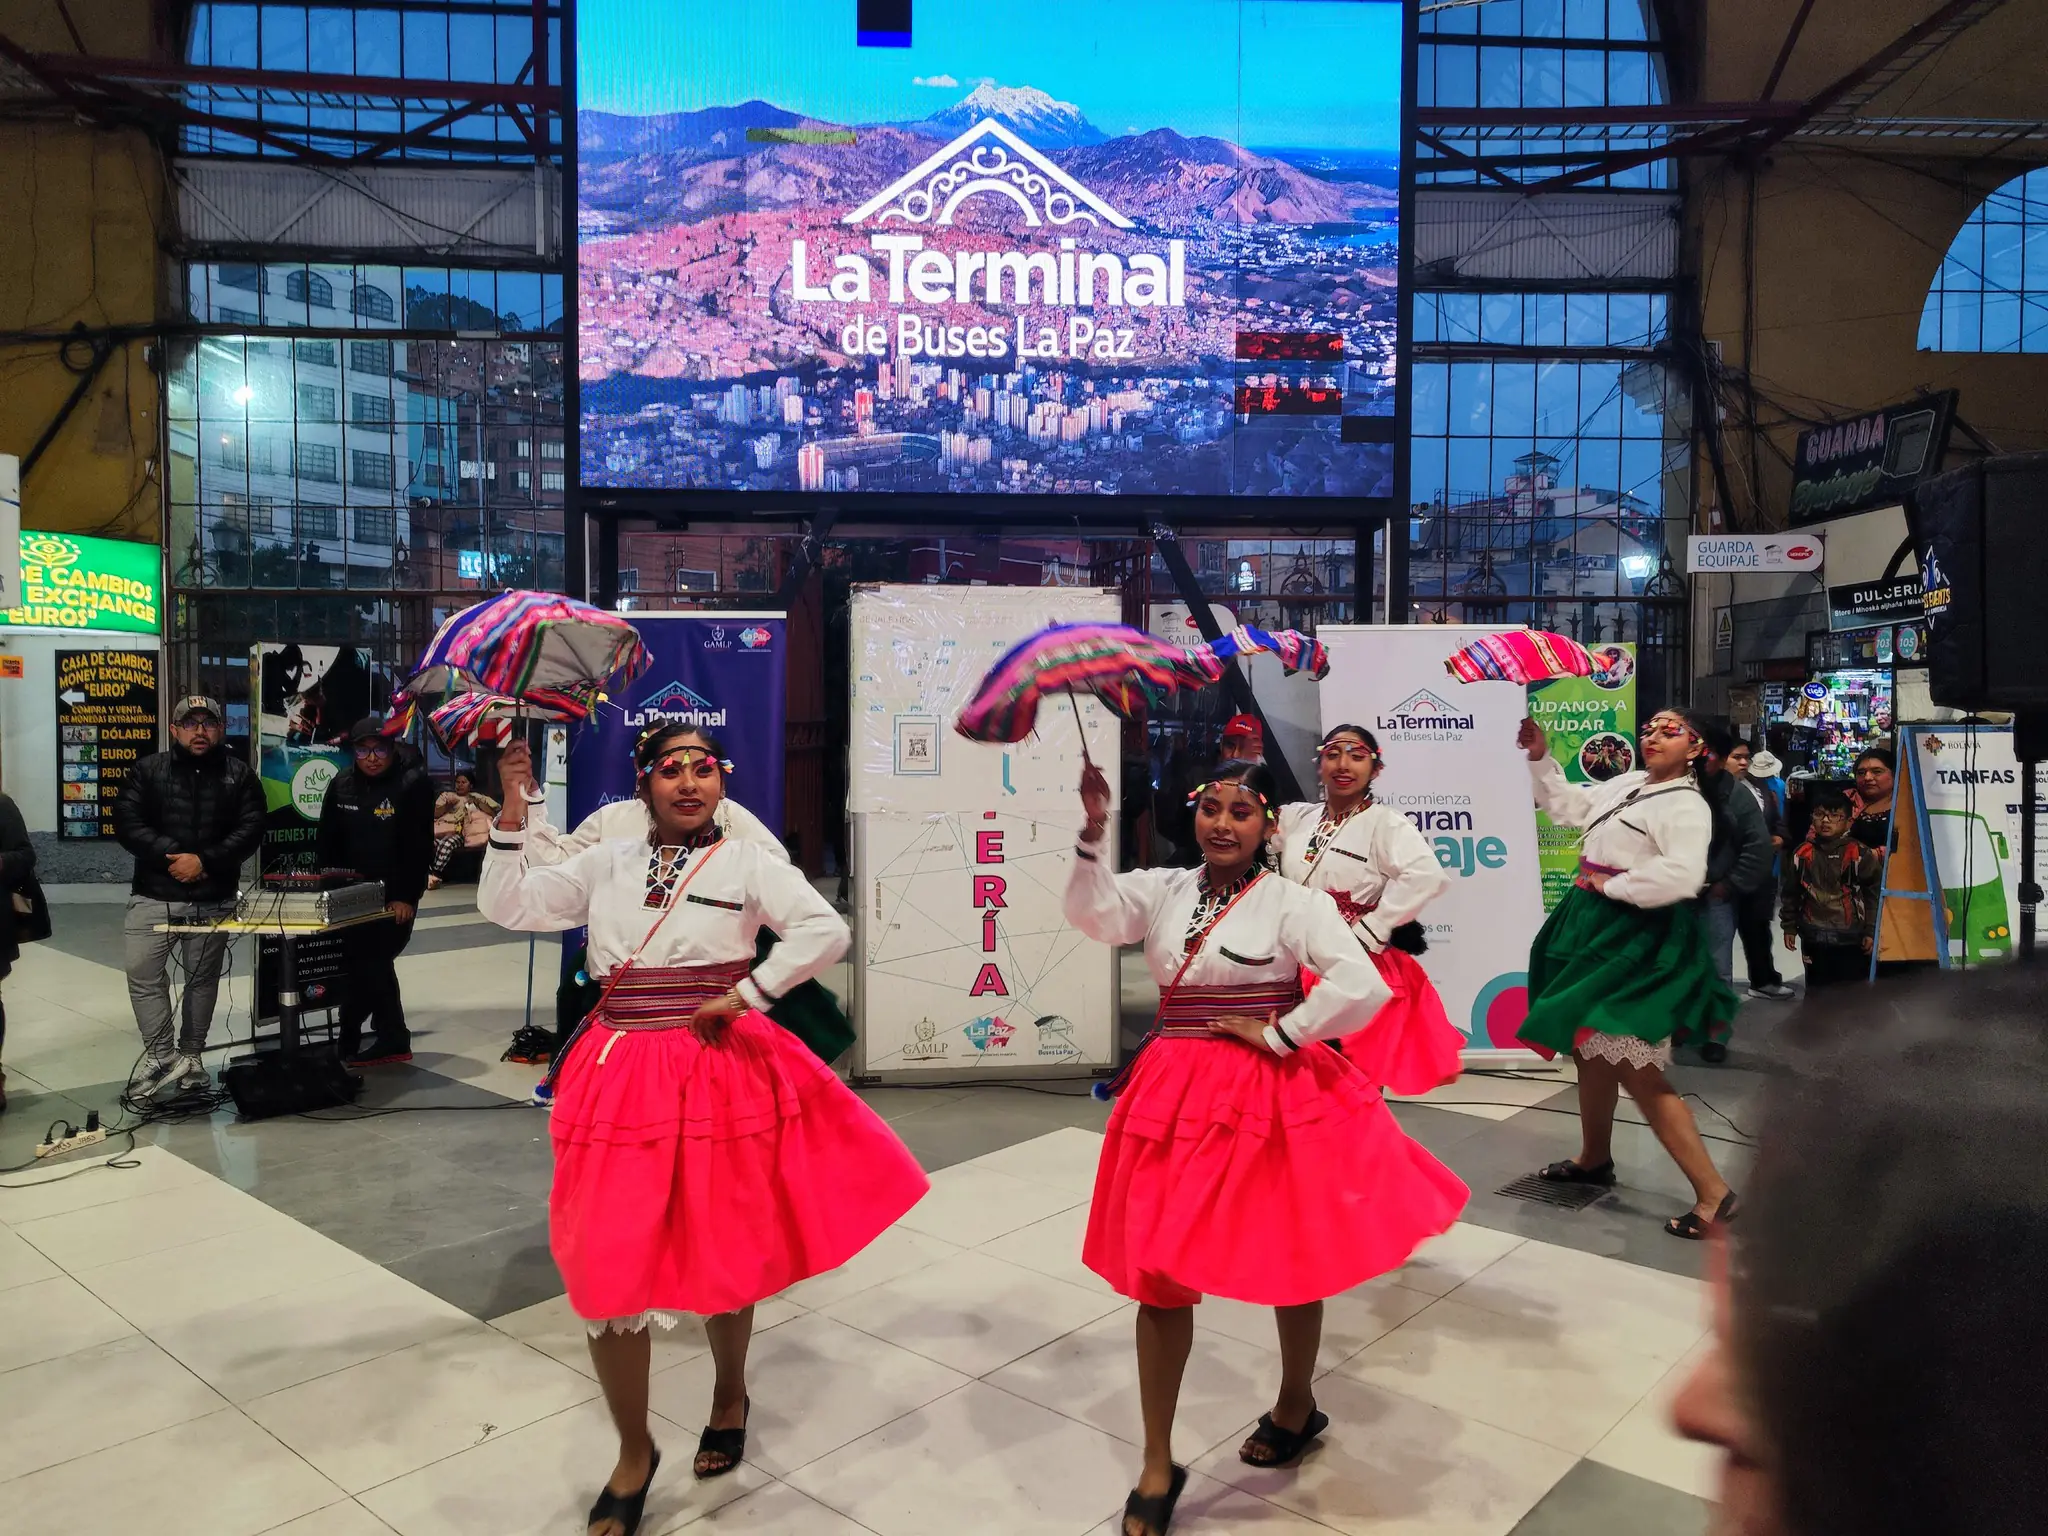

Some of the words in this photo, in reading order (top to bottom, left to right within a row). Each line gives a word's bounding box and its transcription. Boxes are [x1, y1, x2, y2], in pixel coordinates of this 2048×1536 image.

[842, 317, 887, 357] de
[897, 315, 1007, 358] Buses
[1017, 317, 1061, 358] La
[1069, 317, 1136, 360] Paz
[1806, 413, 1885, 466] GUARDA
[1698, 541, 1755, 554] GUARDA
[1698, 554, 1760, 567] EQUIPAJE
[20, 565, 43, 583] E
[50, 567, 153, 602] CAMBIOS
[27, 585, 156, 625] EXCHANGE
[703, 640, 732, 649] GAMLP
[1900, 638, 1915, 647] 105
[62, 653, 89, 673] CASA
[90, 652, 105, 666] DE
[106, 651, 153, 673] CAMBIOS
[59, 668, 97, 689] MONEY
[98, 666, 155, 690] EXCHANGE
[72, 705, 107, 714] COMPRA
[108, 705, 114, 714] Y
[115, 705, 143, 714] VENTA
[1528, 700, 1609, 714] UDANOS
[1613, 699, 1628, 711] A
[60, 715, 70, 723] DE
[70, 714, 107, 723] MONEDAS
[107, 714, 156, 724] EXTRANJERAS
[1534, 719, 1605, 732] YUDAR
[101, 727, 152, 740] DÓLARES
[1390, 732, 1402, 741] de
[1404, 731, 1431, 741] Buses
[1434, 732, 1444, 741] La
[1446, 732, 1463, 742] Paz
[101, 748, 137, 760] EUROS
[102, 768, 121, 778] PESO
[1936, 769, 2015, 785] TARIFAS
[1398, 792, 1471, 805] comienza
[1424, 835, 1508, 878] aje
[969, 811, 1010, 997] ERÍA
[1436, 924, 1453, 933] en:
[970, 1024, 985, 1036] La
[987, 1024, 1009, 1036] Paz
[902, 1042, 949, 1055] GAMLP
